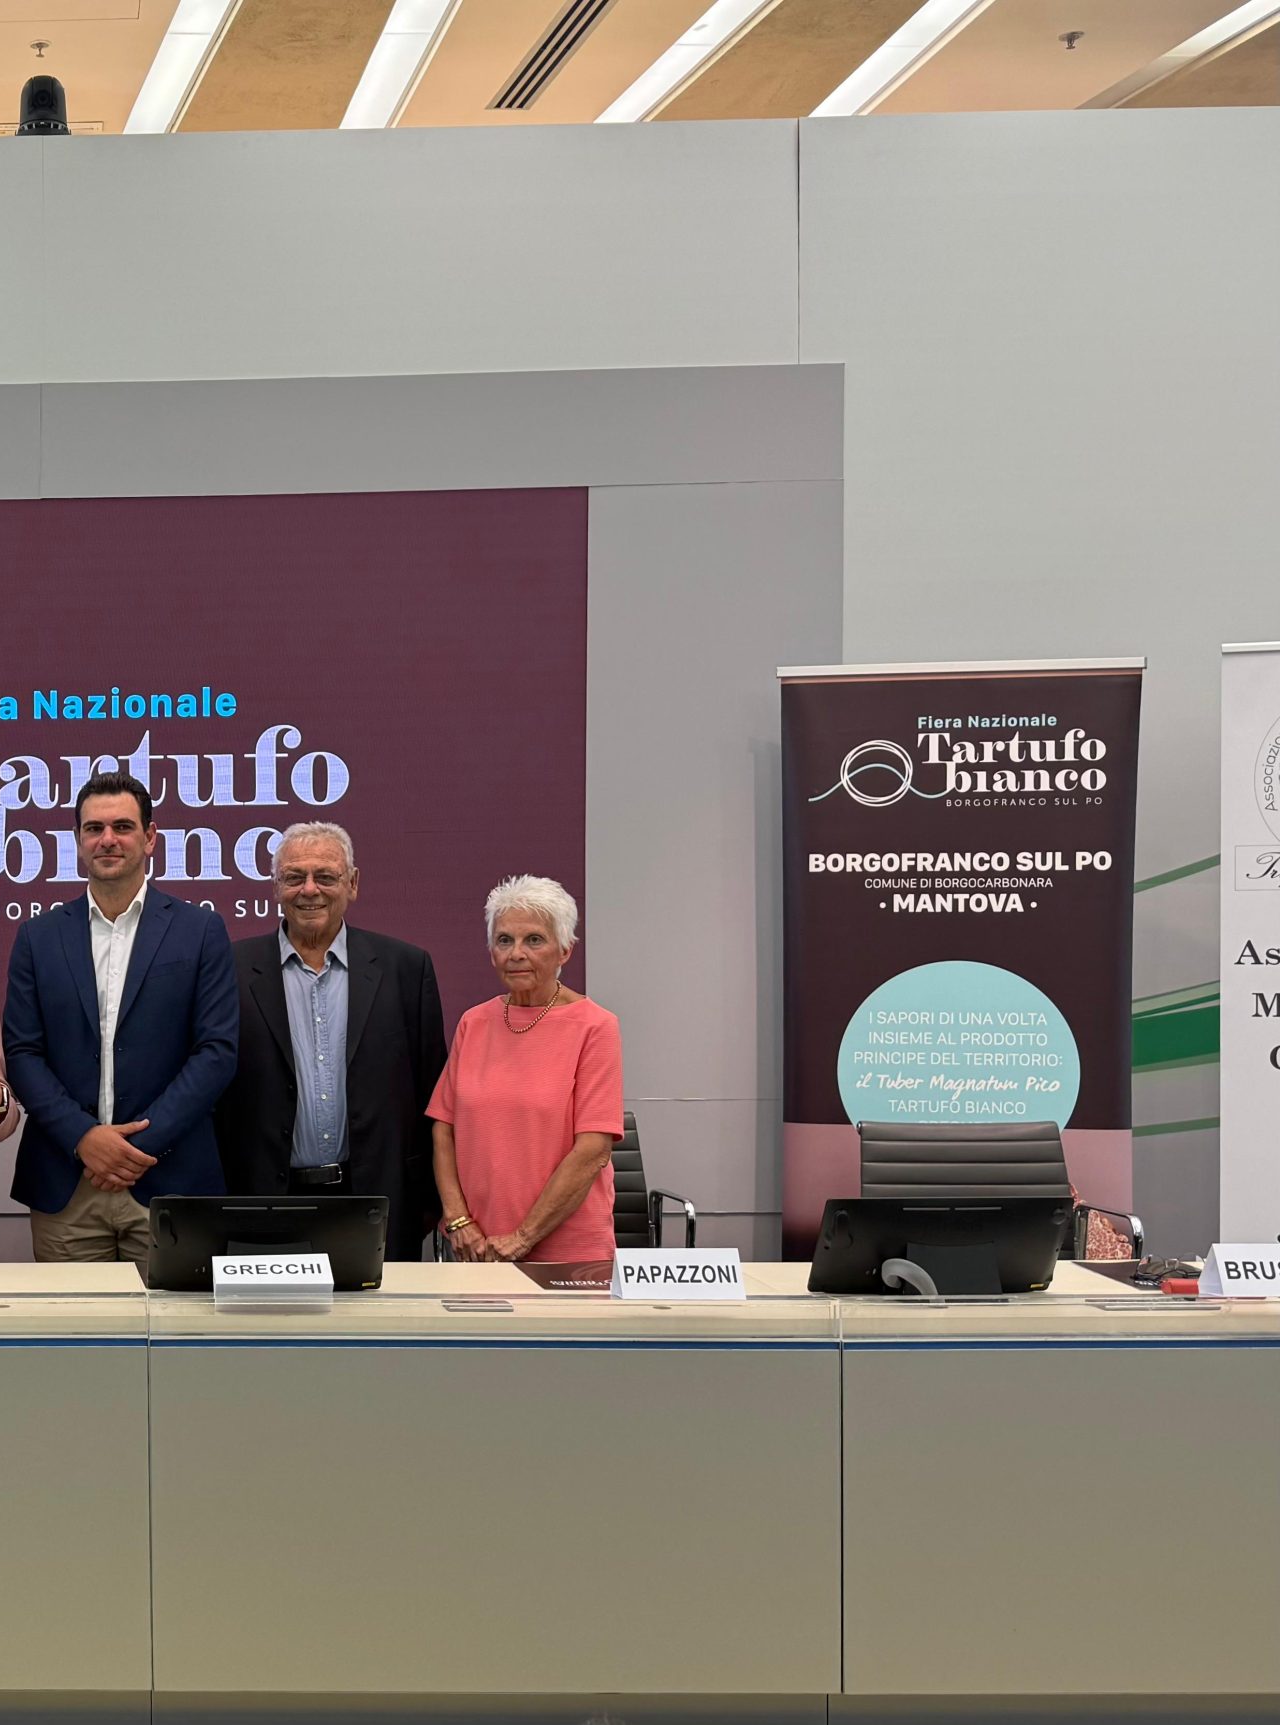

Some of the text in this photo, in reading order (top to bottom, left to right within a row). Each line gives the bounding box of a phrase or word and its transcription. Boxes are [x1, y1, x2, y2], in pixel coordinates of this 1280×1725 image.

[33, 687, 237, 719] Nazionale
[918, 713, 1057, 729] Fiera Nazionale
[917, 728, 1107, 764] Tartufo
[945, 761, 1107, 793] bianco
[946, 797, 1103, 807] BORGOFRANCO SUL PO
[808, 851, 1112, 872] BORGOFRANCO SUL PO
[864, 877, 1053, 889] COMUNE DI BORGOCARBONARA
[893, 893, 1024, 912] MANTOVA
[876, 1011, 934, 1025] SAPORI
[939, 1012, 954, 1025] DI
[959, 1012, 993, 1025] UNA
[997, 1012, 1047, 1026] VOLTA
[869, 1031, 1048, 1047] INSIEME AL PRODOTTO
[854, 1051, 1063, 1067] PRINCIPE DEL TERRITORIO:
[856, 1072, 1060, 1100] il Tuber Magnatum Pico
[888, 1099, 1026, 1115] TARTUFO BIANCO
[223, 1263, 322, 1275] GRECCHI
[623, 1265, 738, 1284] PAPAZZONI
[1224, 1261, 1280, 1280] BRU
